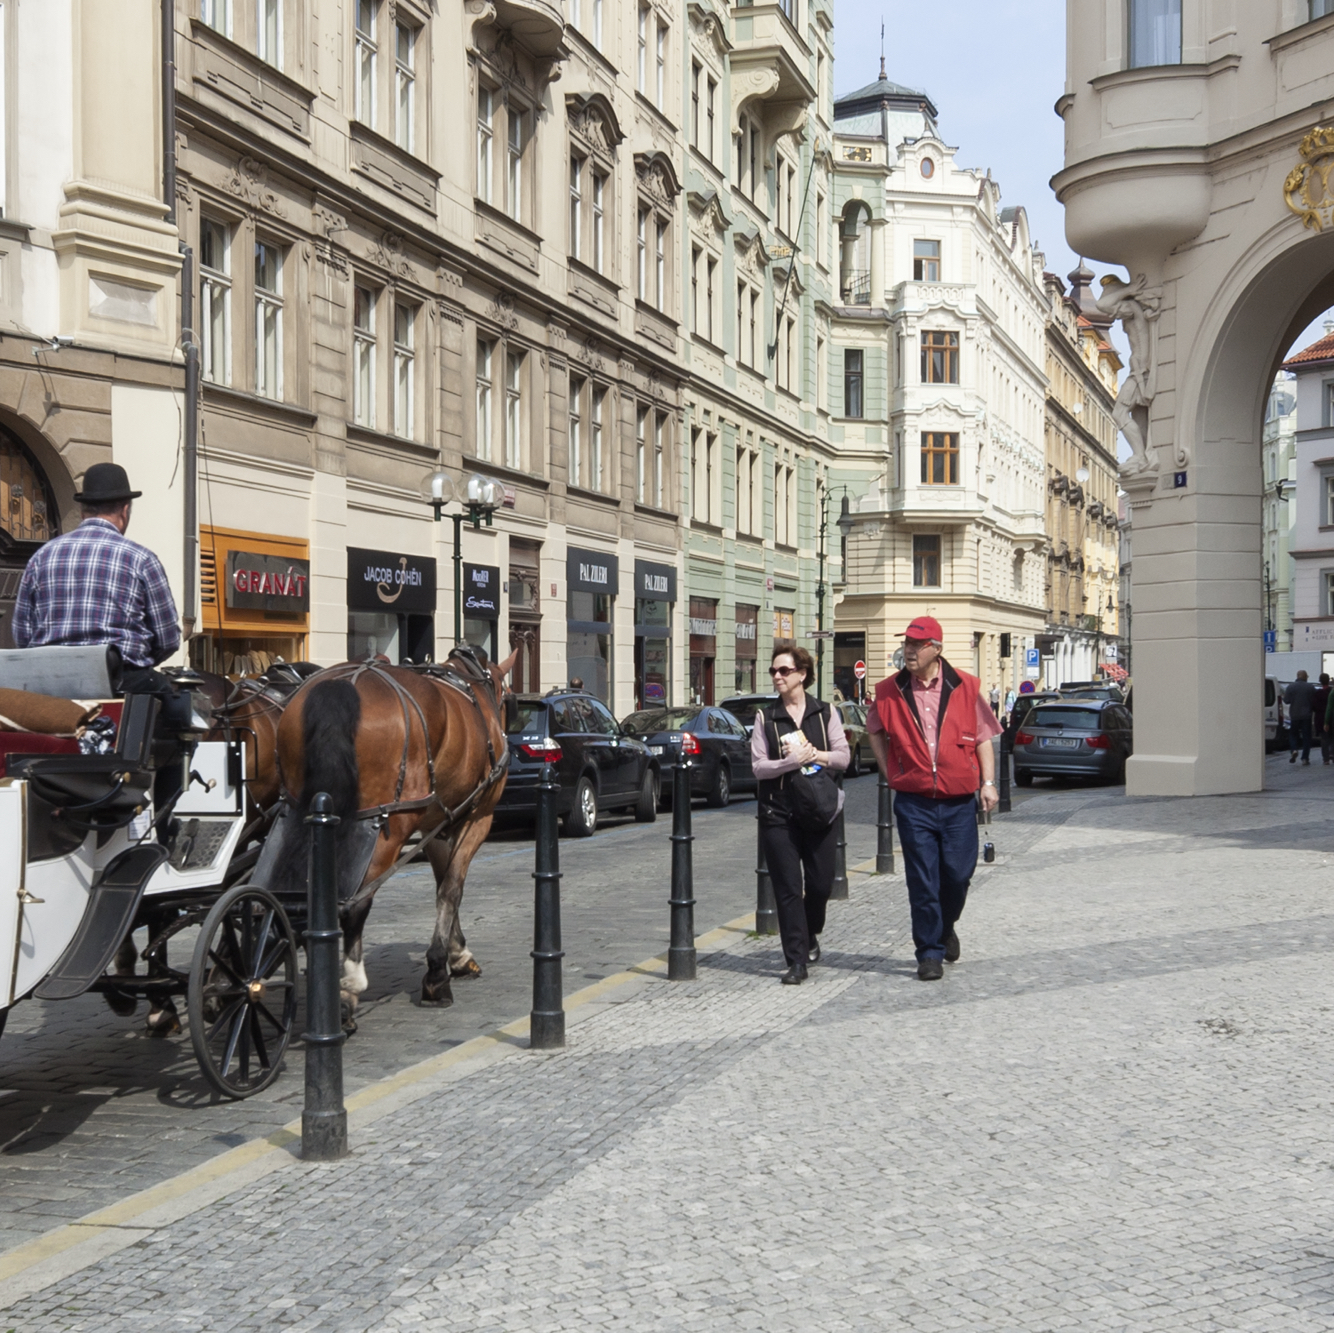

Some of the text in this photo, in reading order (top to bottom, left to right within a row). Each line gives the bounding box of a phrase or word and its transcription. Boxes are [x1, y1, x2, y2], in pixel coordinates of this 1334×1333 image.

[1177, 474, 1183, 485] 9
[364, 566, 392, 584] JACOB
[579, 562, 591, 581] PAL
[234, 565, 307, 597] GRANÁT
[644, 573, 654, 590] PAL
[1028, 650, 1037, 663] P
